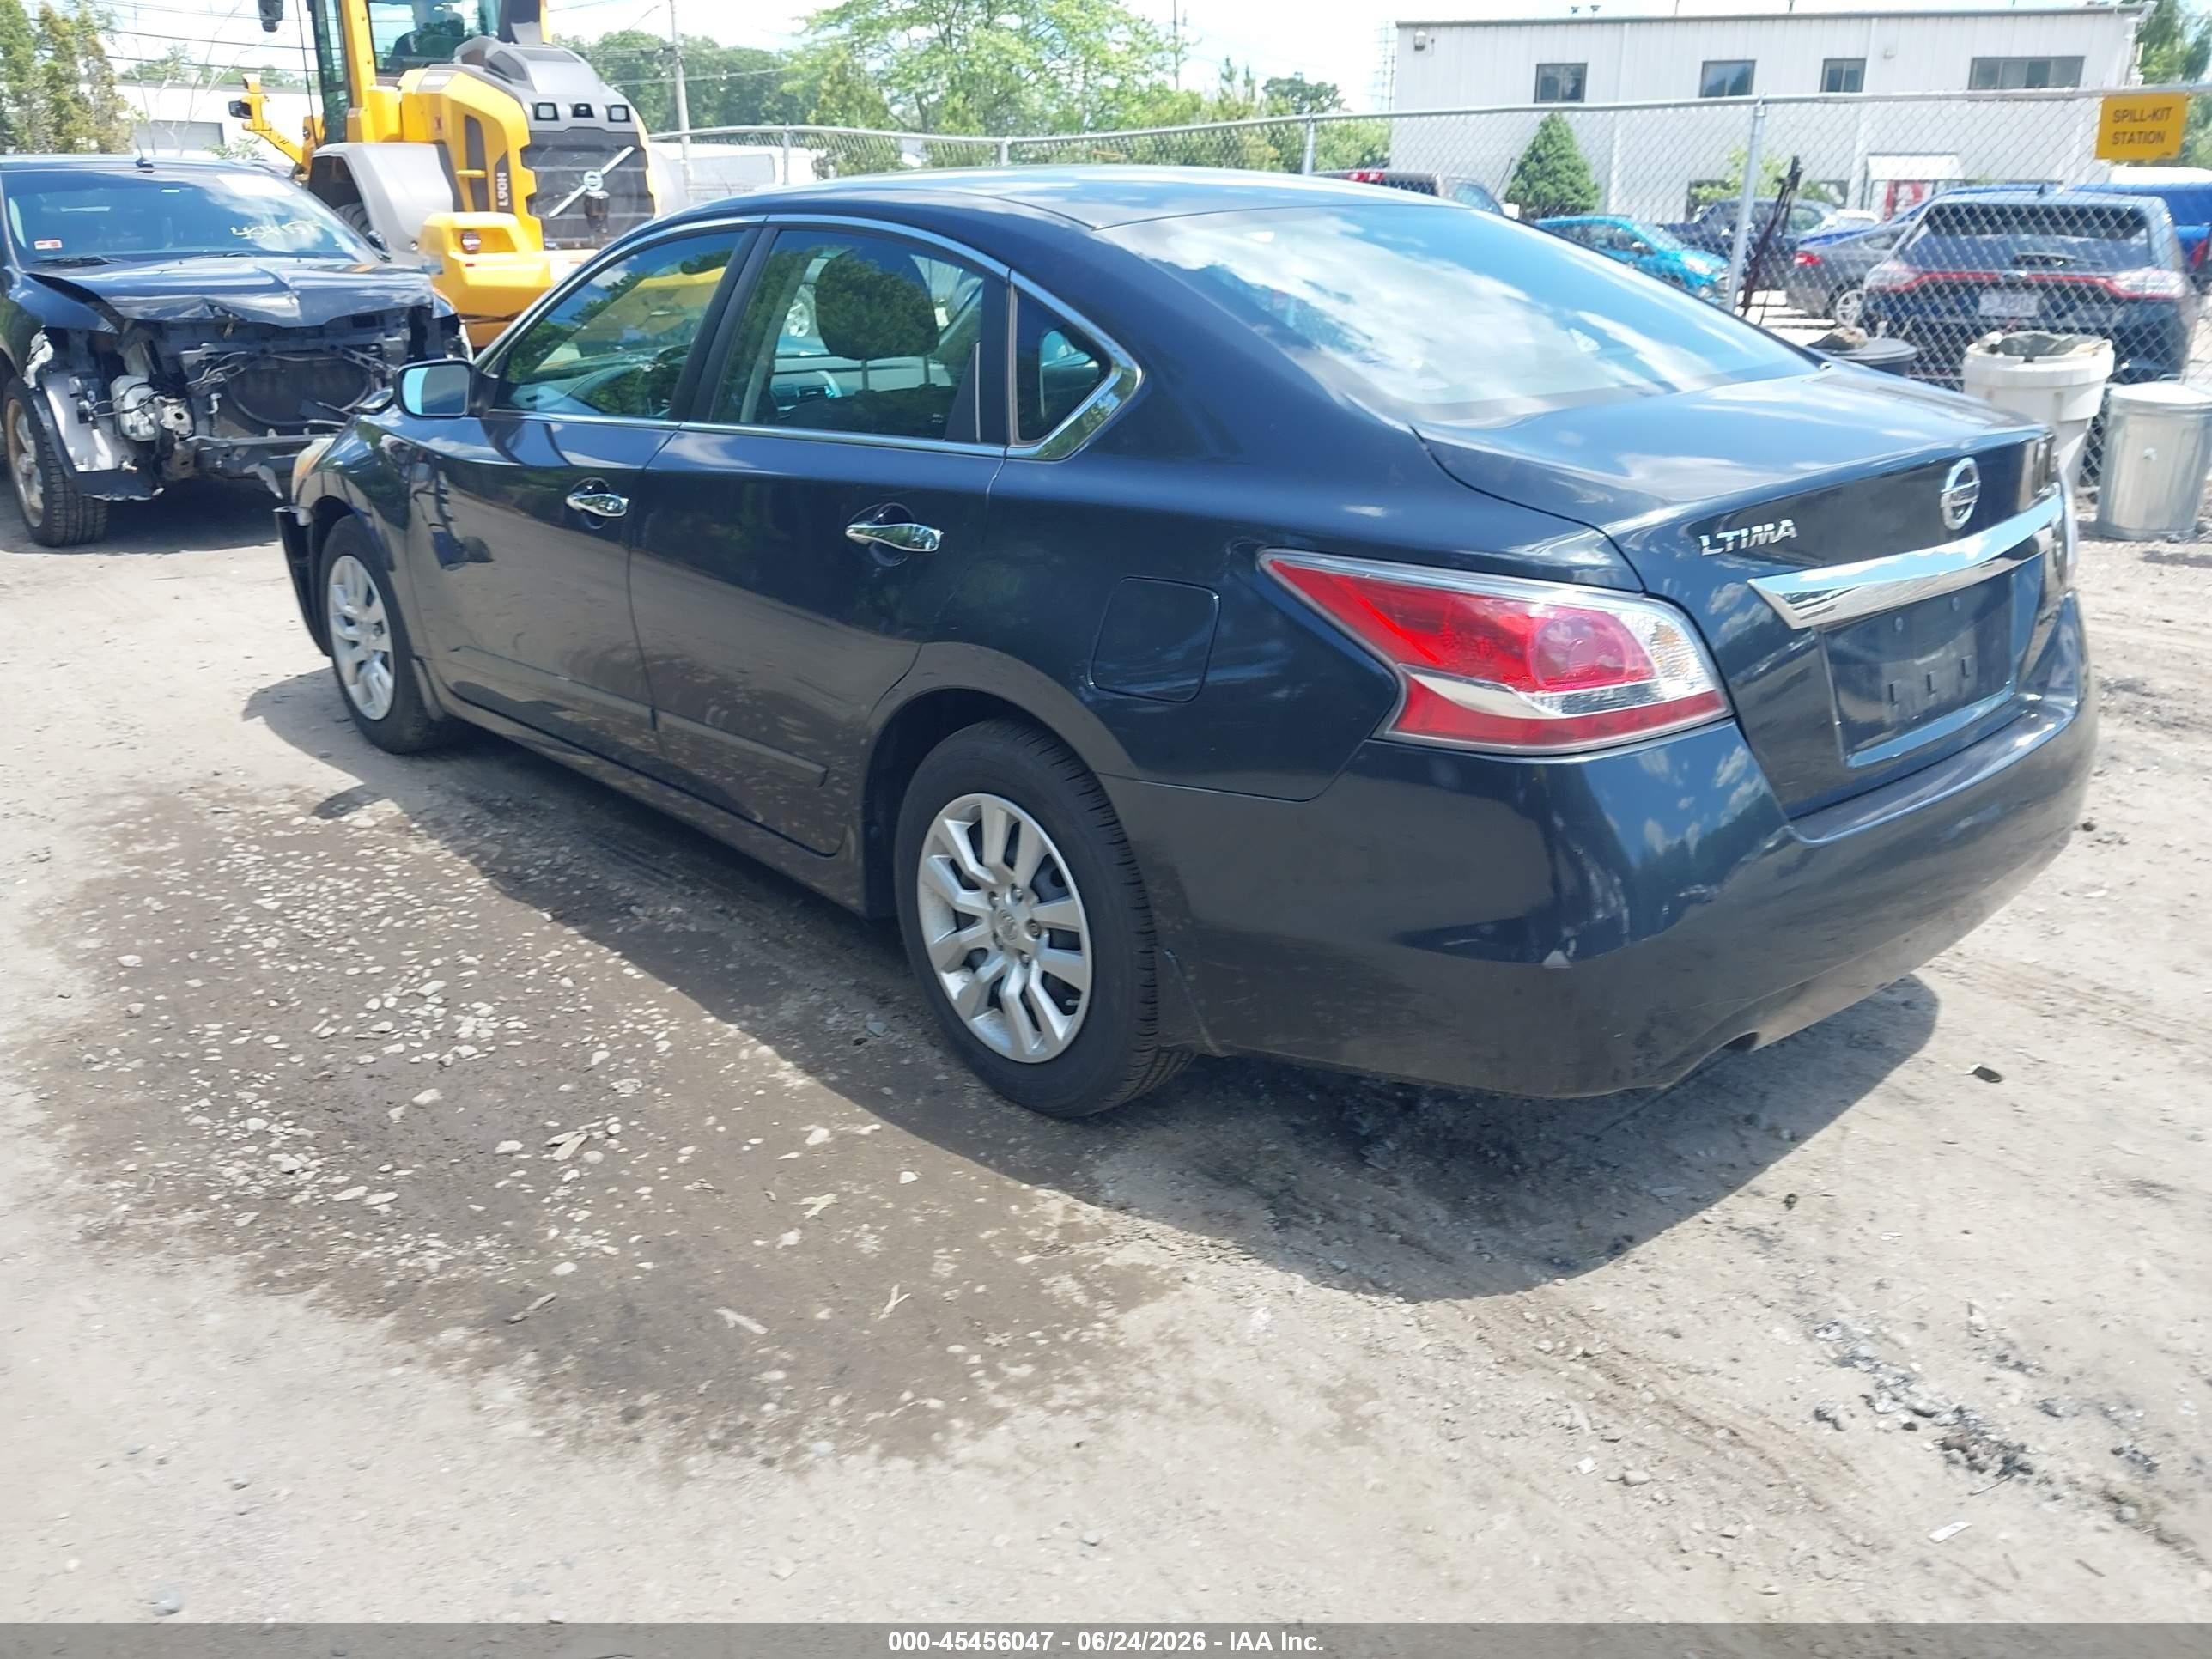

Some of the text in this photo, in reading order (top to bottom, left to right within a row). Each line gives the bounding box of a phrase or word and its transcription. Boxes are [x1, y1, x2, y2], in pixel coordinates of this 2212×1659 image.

[2112, 107, 2172, 123] SPILL-KIT
[2112, 131, 2166, 145] STATION
[496, 172, 509, 206] L90H
[1698, 519, 1798, 556] LTIMA
